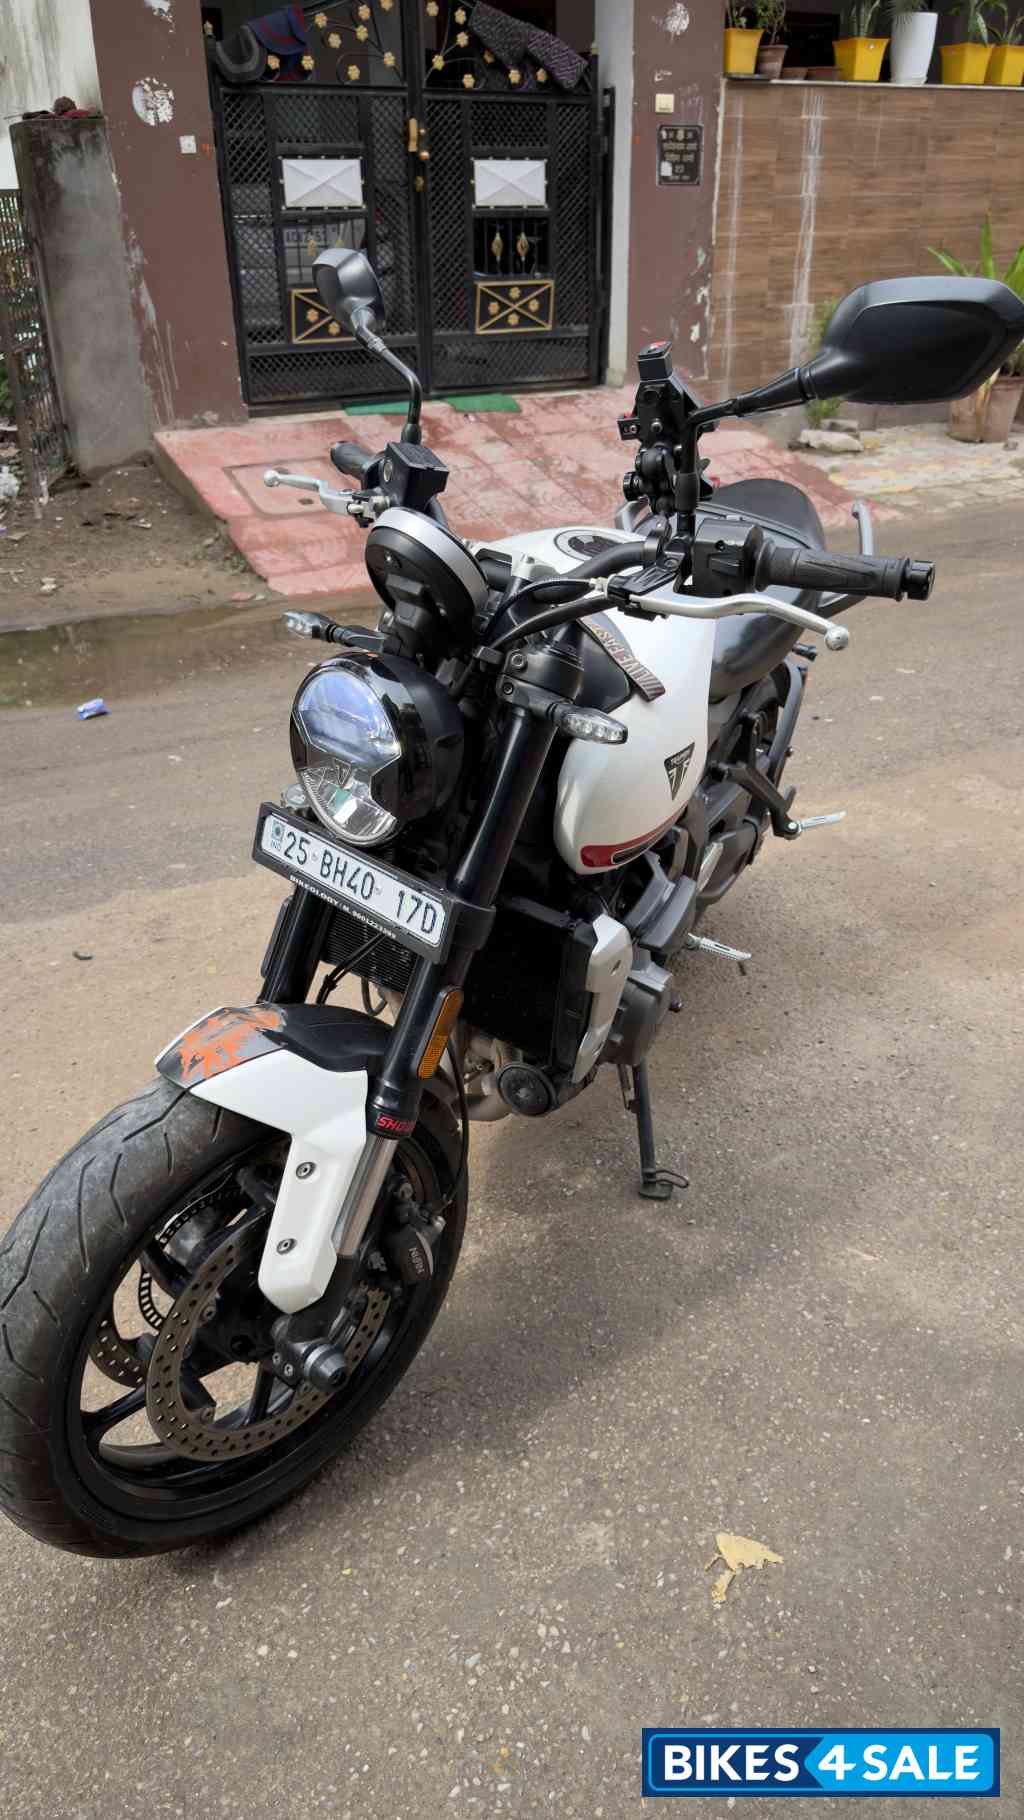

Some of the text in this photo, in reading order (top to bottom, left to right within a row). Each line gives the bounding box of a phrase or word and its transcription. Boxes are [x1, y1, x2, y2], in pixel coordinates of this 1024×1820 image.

[283, 831, 437, 934] 25 BH40 17D
